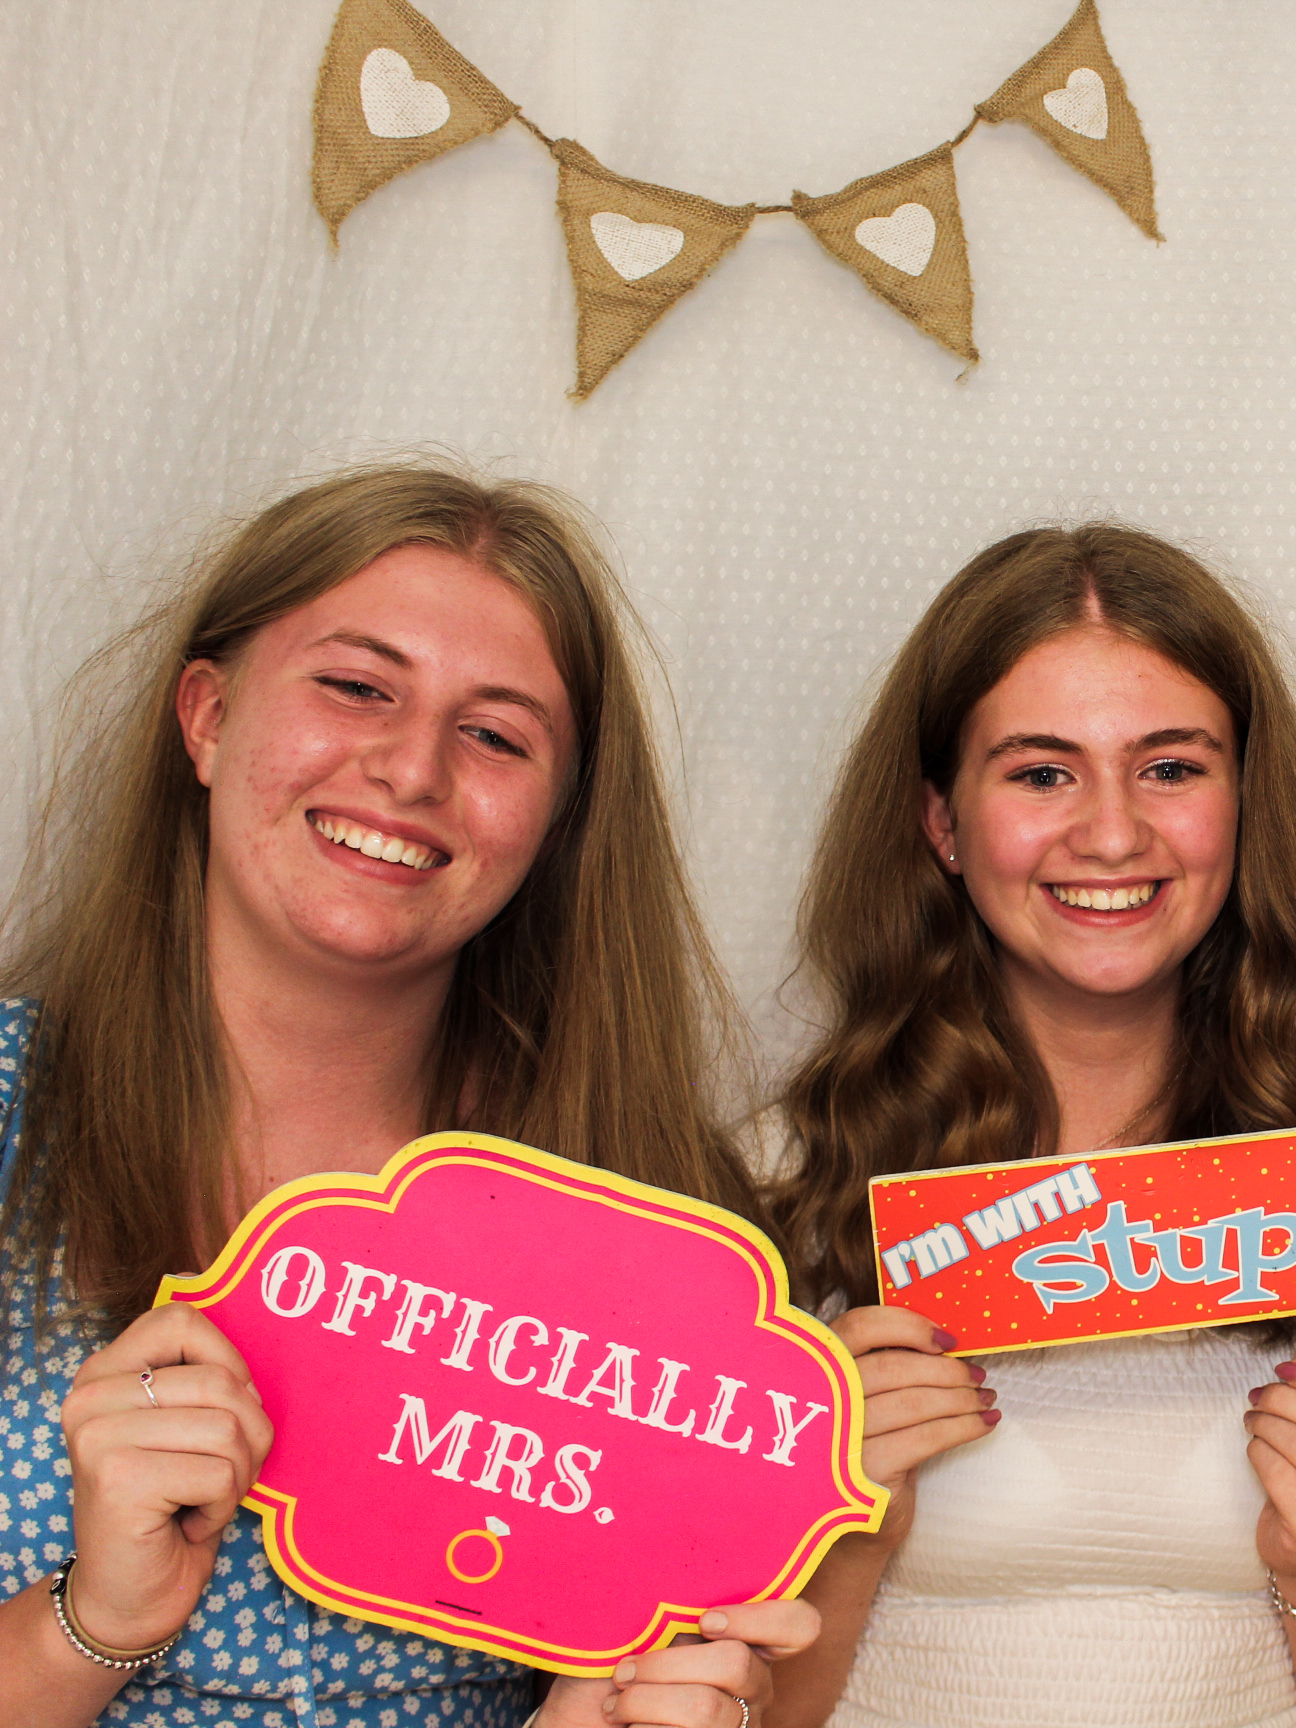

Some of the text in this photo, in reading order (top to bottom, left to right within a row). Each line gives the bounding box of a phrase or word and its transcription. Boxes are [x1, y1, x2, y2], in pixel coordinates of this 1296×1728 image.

[962, 1162, 1102, 1249] WITH
[260, 1246, 829, 1467] OFFICIALLY
[378, 1394, 615, 1524] MRS.
